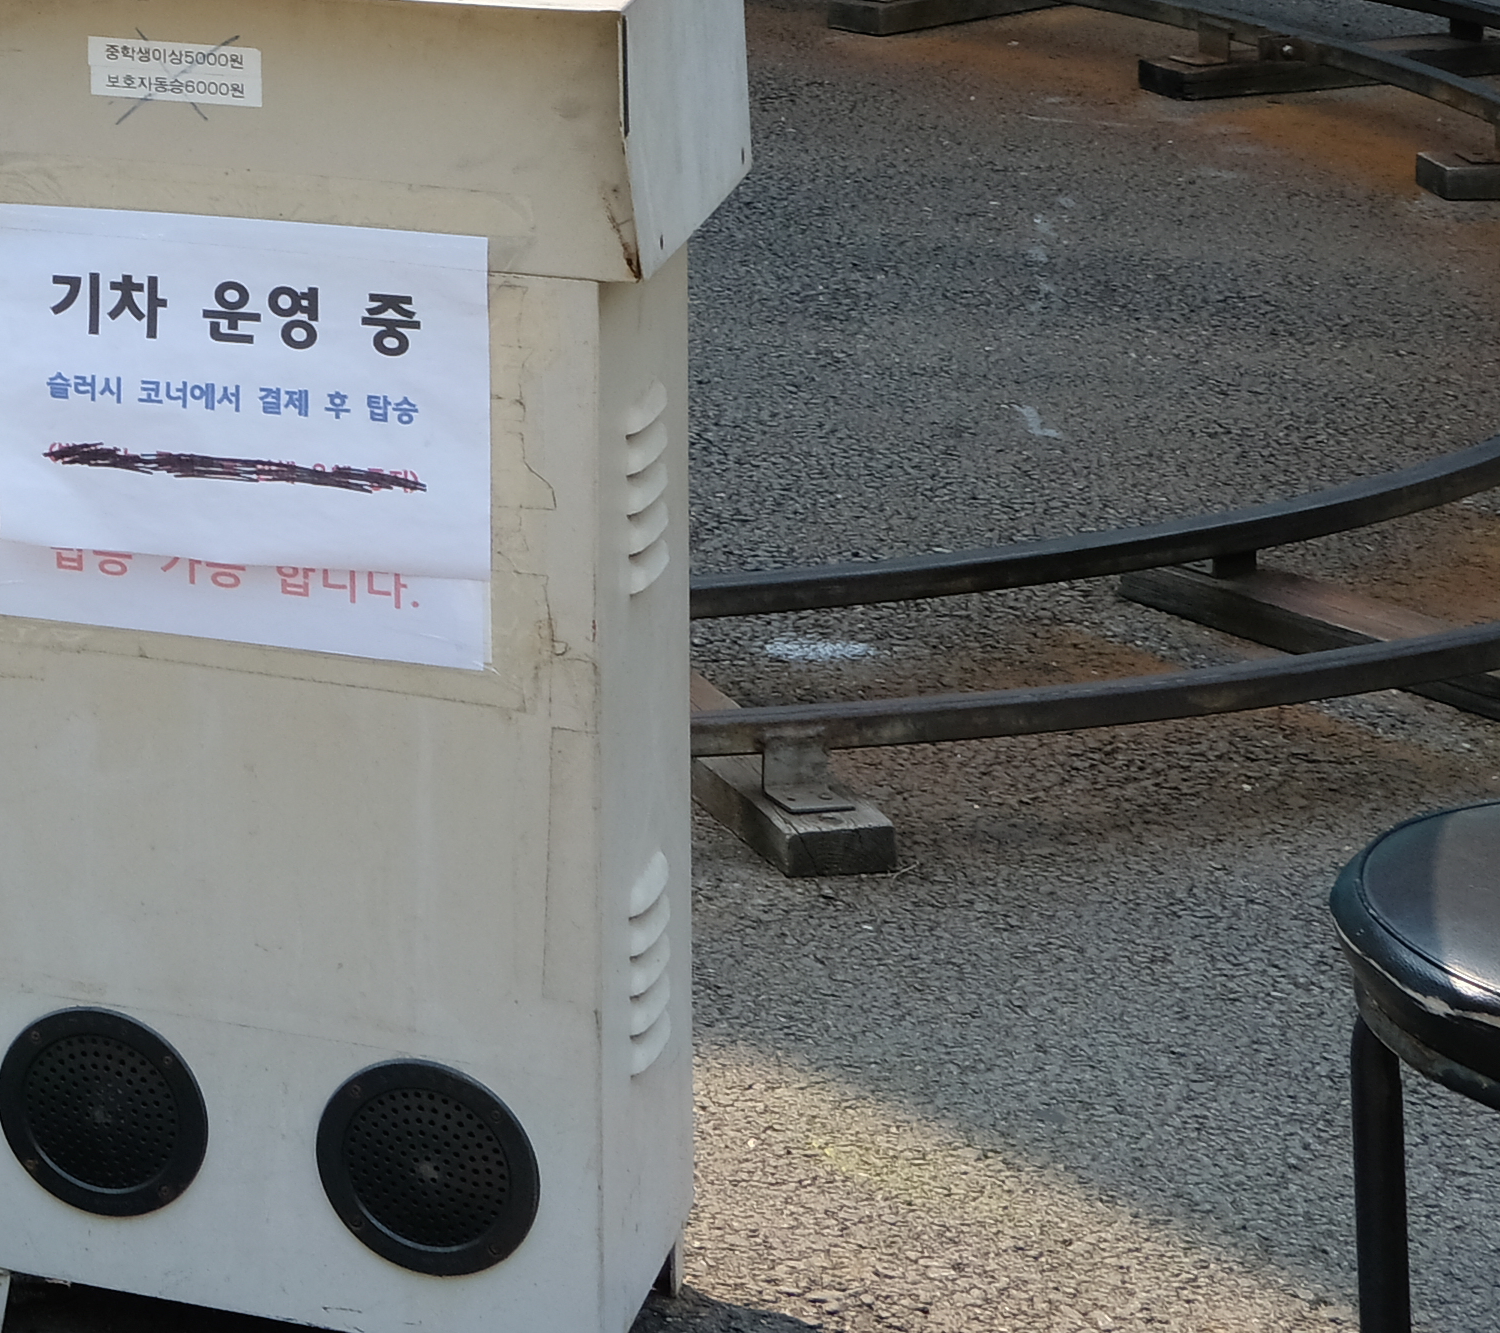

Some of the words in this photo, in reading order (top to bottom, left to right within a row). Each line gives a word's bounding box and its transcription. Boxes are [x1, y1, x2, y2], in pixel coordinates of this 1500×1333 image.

[105, 43, 244, 70] 중학생이상5000원
[105, 73, 246, 99] 보호자동승6000원
[50, 271, 168, 340] 기차
[202, 280, 319, 350] 운영
[361, 292, 422, 357] 중
[46, 371, 122, 405] 슬러시
[137, 379, 241, 413] 코너에서
[257, 386, 310, 418] 결제
[324, 390, 352, 420] 후
[366, 394, 419, 425] 탑승
